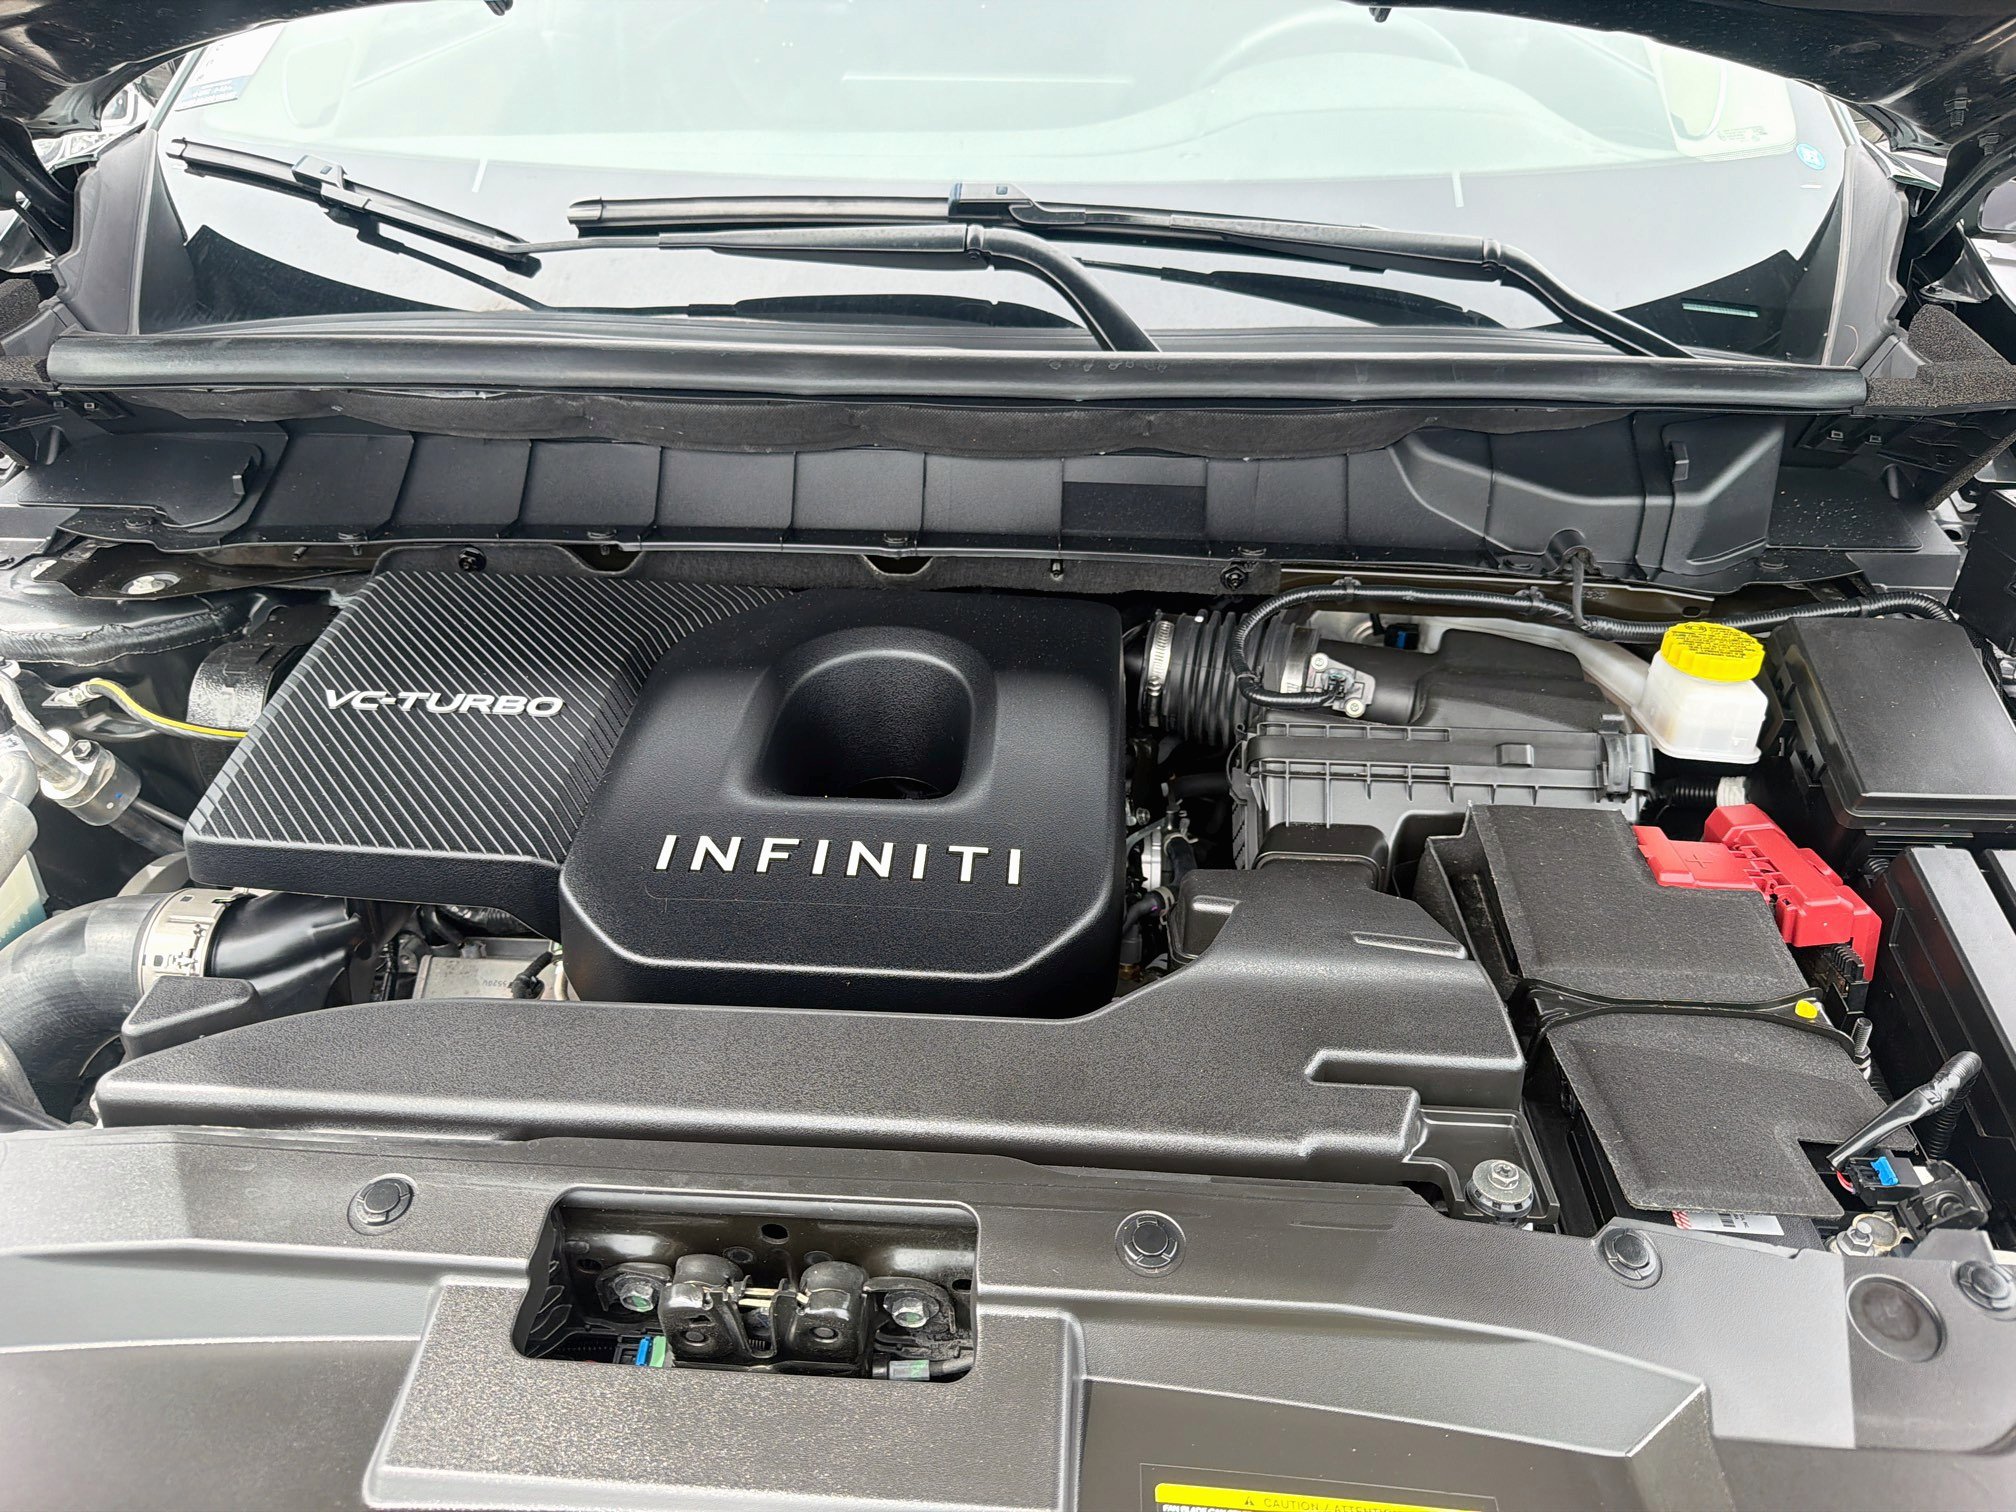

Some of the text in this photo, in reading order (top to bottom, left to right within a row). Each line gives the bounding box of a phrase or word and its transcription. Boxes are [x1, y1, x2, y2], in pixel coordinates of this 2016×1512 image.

[325, 689, 564, 718] VC-TURBO
[654, 834, 1022, 885] INFINITI
[1263, 1498, 1319, 1511] CAUTION
[1335, 1503, 1398, 1512] ATTEN
